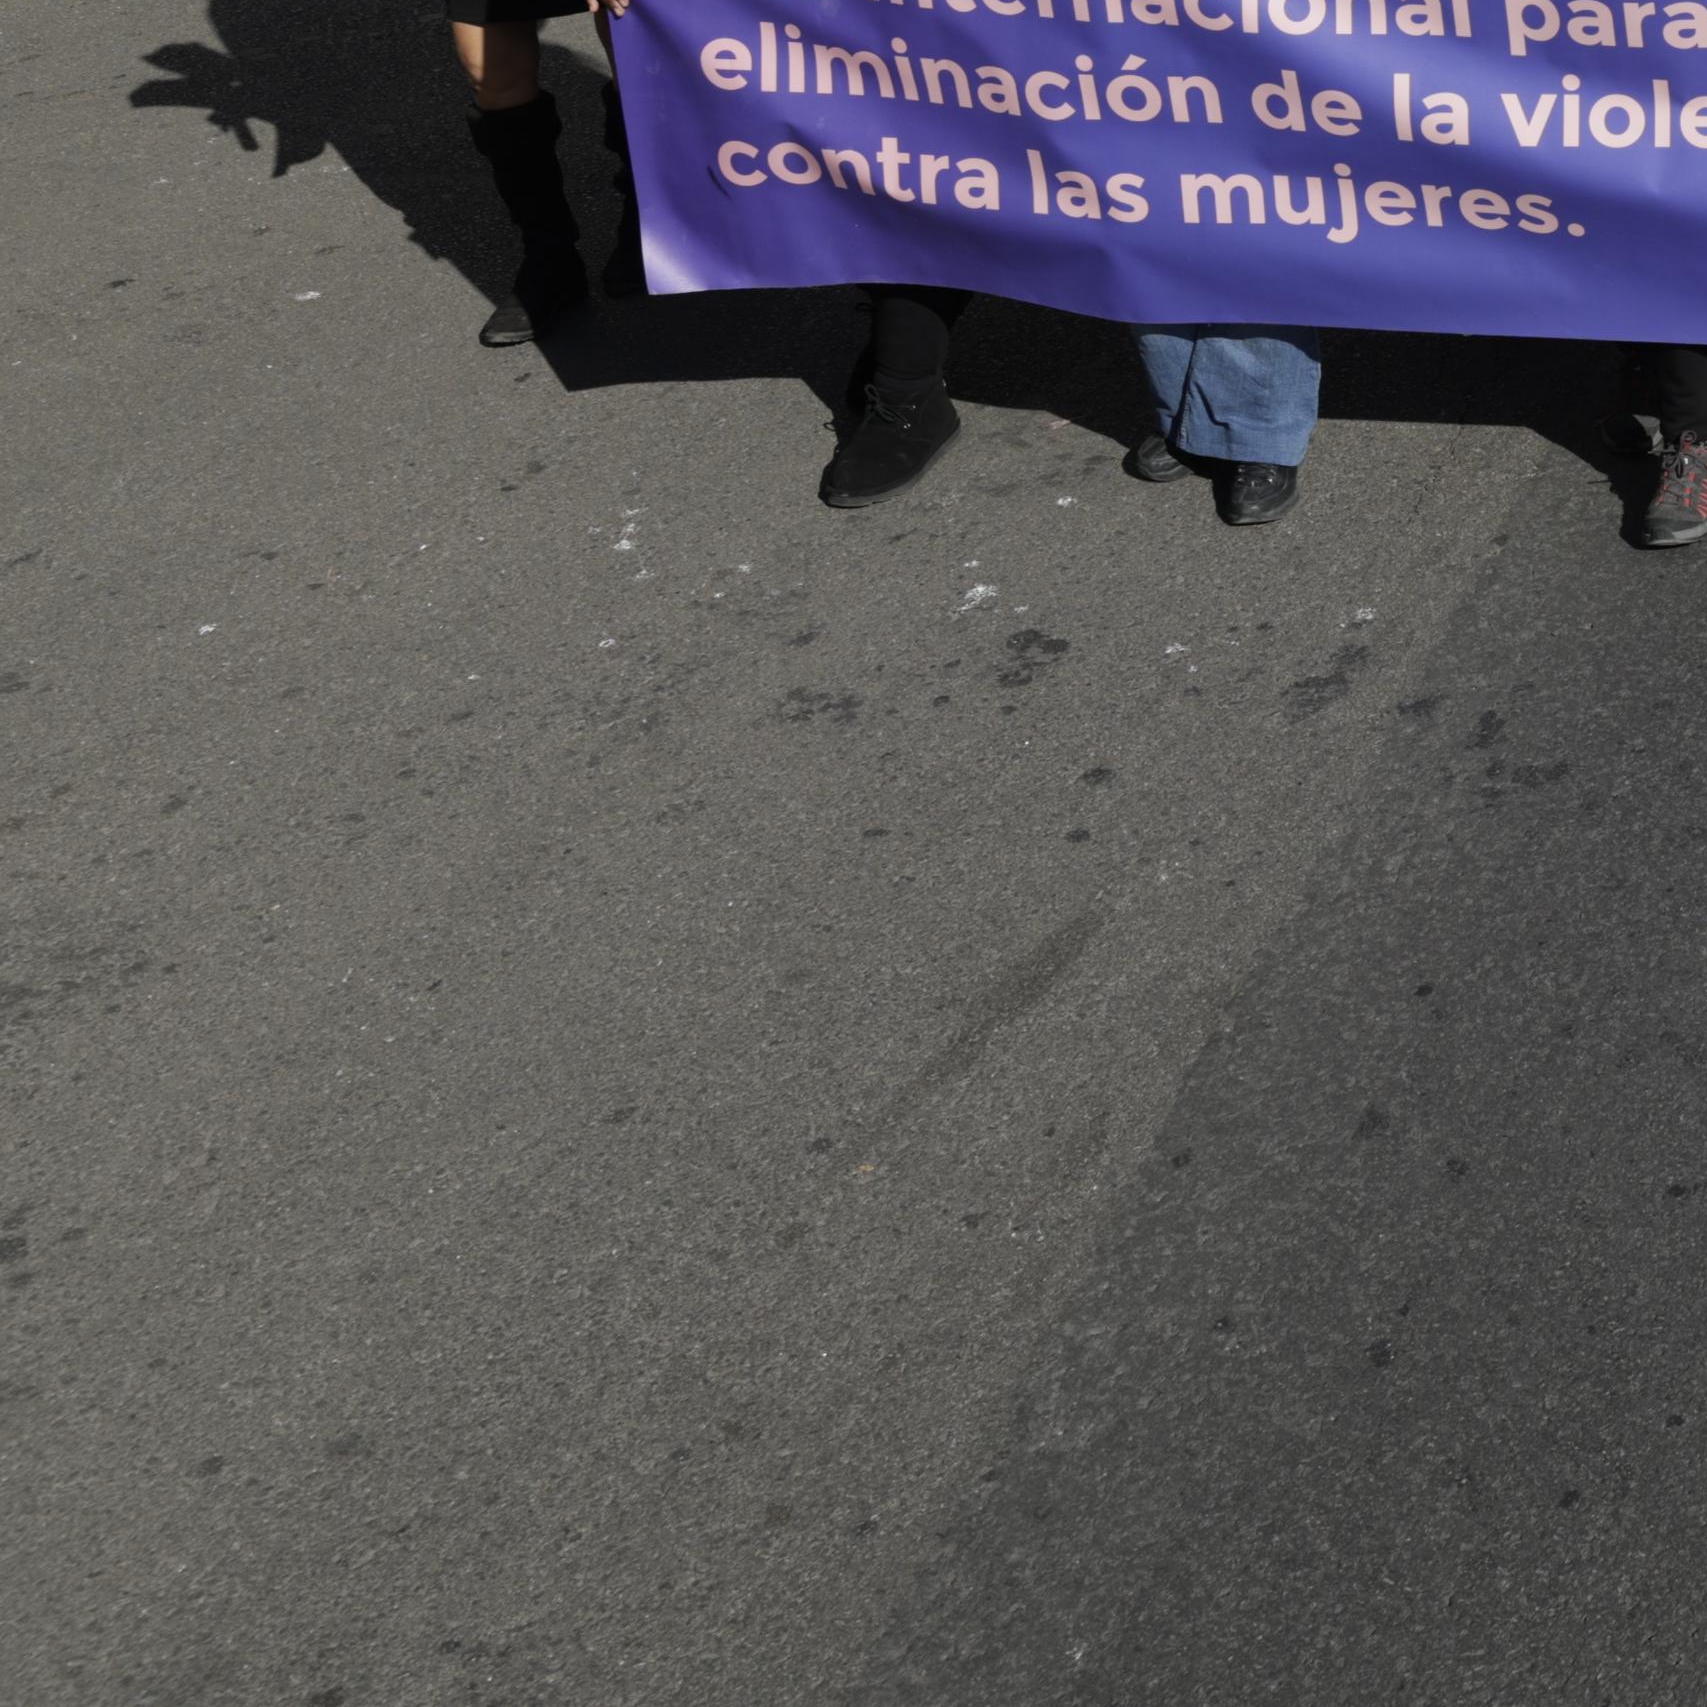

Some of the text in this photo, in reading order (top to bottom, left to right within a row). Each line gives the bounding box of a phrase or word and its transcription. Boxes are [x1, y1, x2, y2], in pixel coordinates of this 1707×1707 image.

[700, 21, 1224, 123] eliminación
[1252, 69, 1362, 136] de
[1393, 73, 1470, 146] la
[717, 136, 1586, 244] contra las mujeres.
